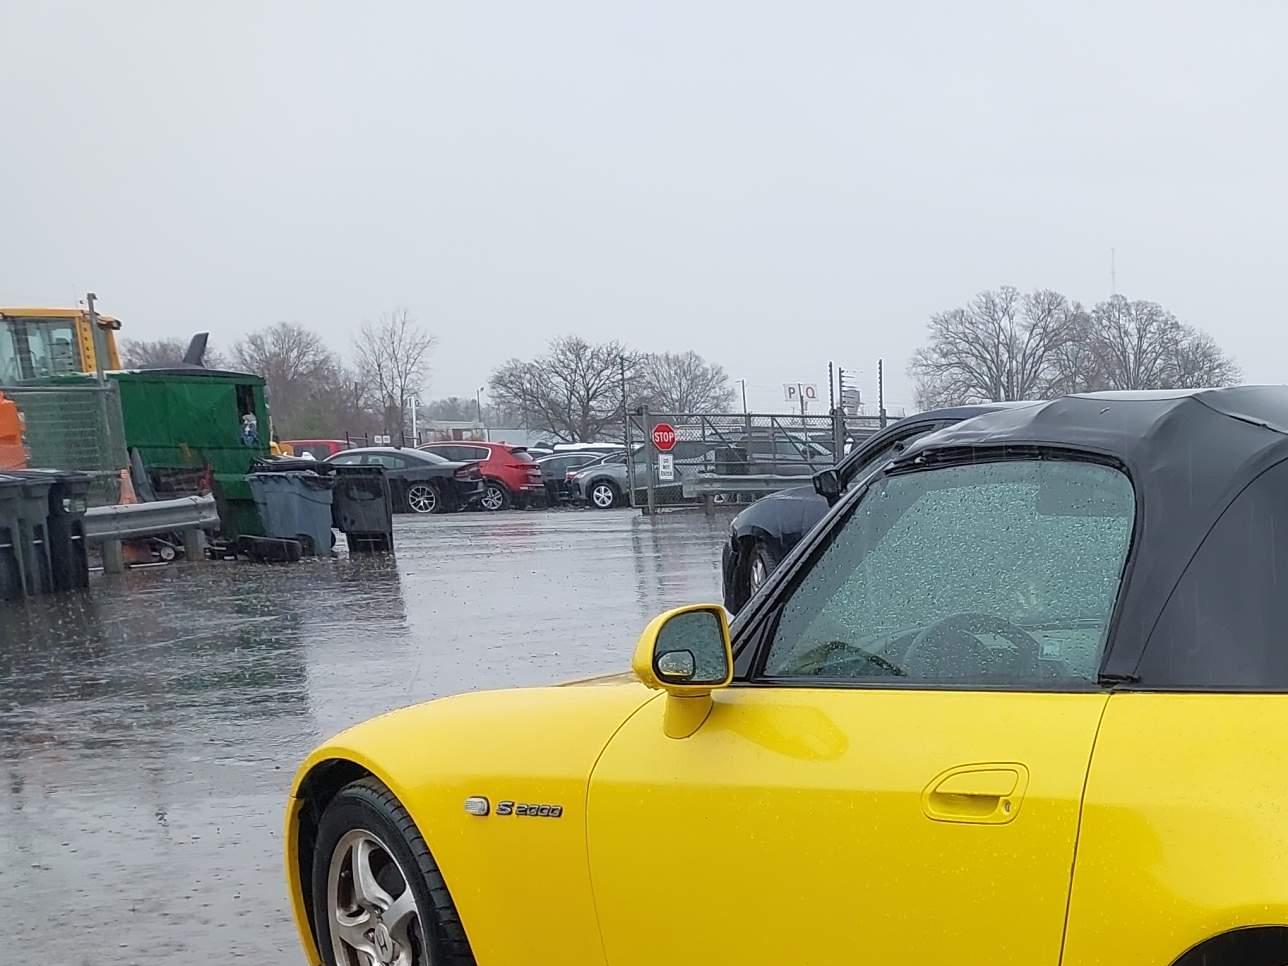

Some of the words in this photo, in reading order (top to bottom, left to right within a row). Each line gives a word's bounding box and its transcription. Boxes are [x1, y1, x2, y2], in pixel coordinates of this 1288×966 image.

[788, 386, 796, 399] P
[805, 386, 816, 399] Q
[654, 432, 674, 443] STOP
